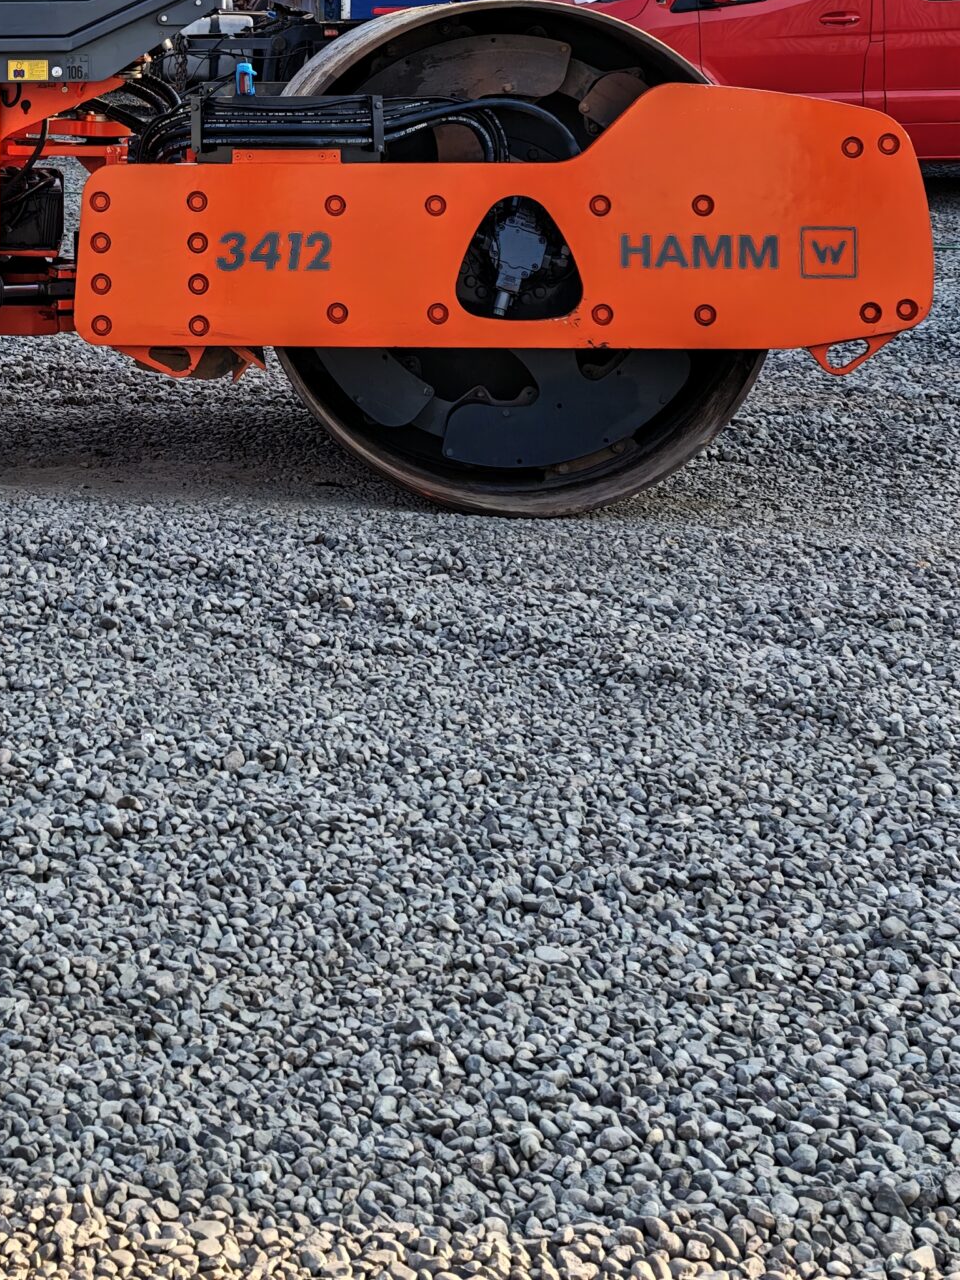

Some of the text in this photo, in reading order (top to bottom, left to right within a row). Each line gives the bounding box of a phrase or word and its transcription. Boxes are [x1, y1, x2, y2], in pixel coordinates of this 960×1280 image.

[66, 65, 84, 80] 106
[216, 231, 332, 272] 3412
[620, 233, 778, 269] HAMM
